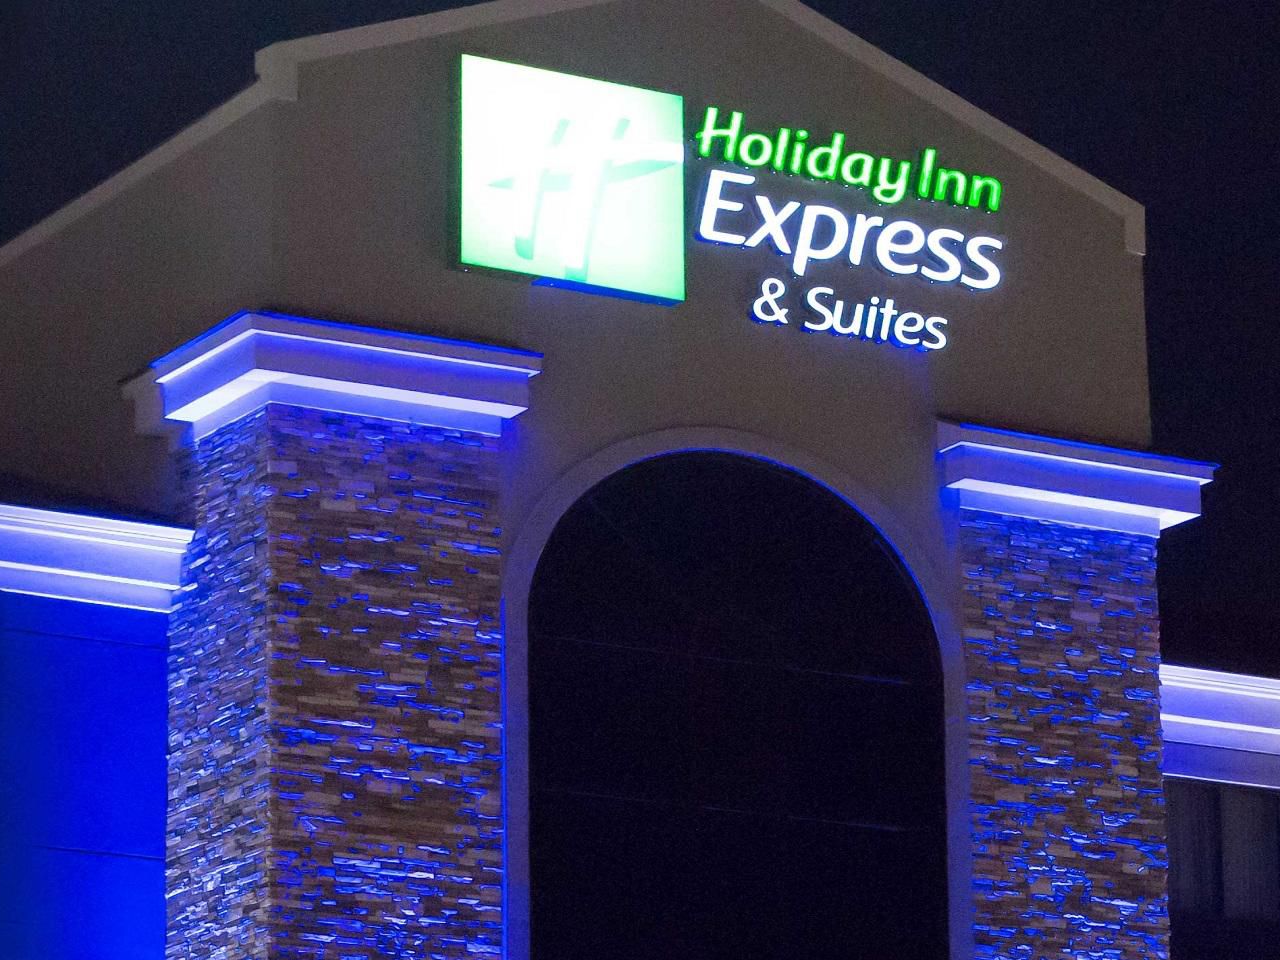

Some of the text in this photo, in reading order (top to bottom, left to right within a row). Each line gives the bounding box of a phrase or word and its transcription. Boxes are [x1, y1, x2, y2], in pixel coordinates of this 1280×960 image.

[696, 106, 1004, 213] Holiday Inn
[699, 168, 1004, 291] Express
[752, 277, 949, 350] & Suites
